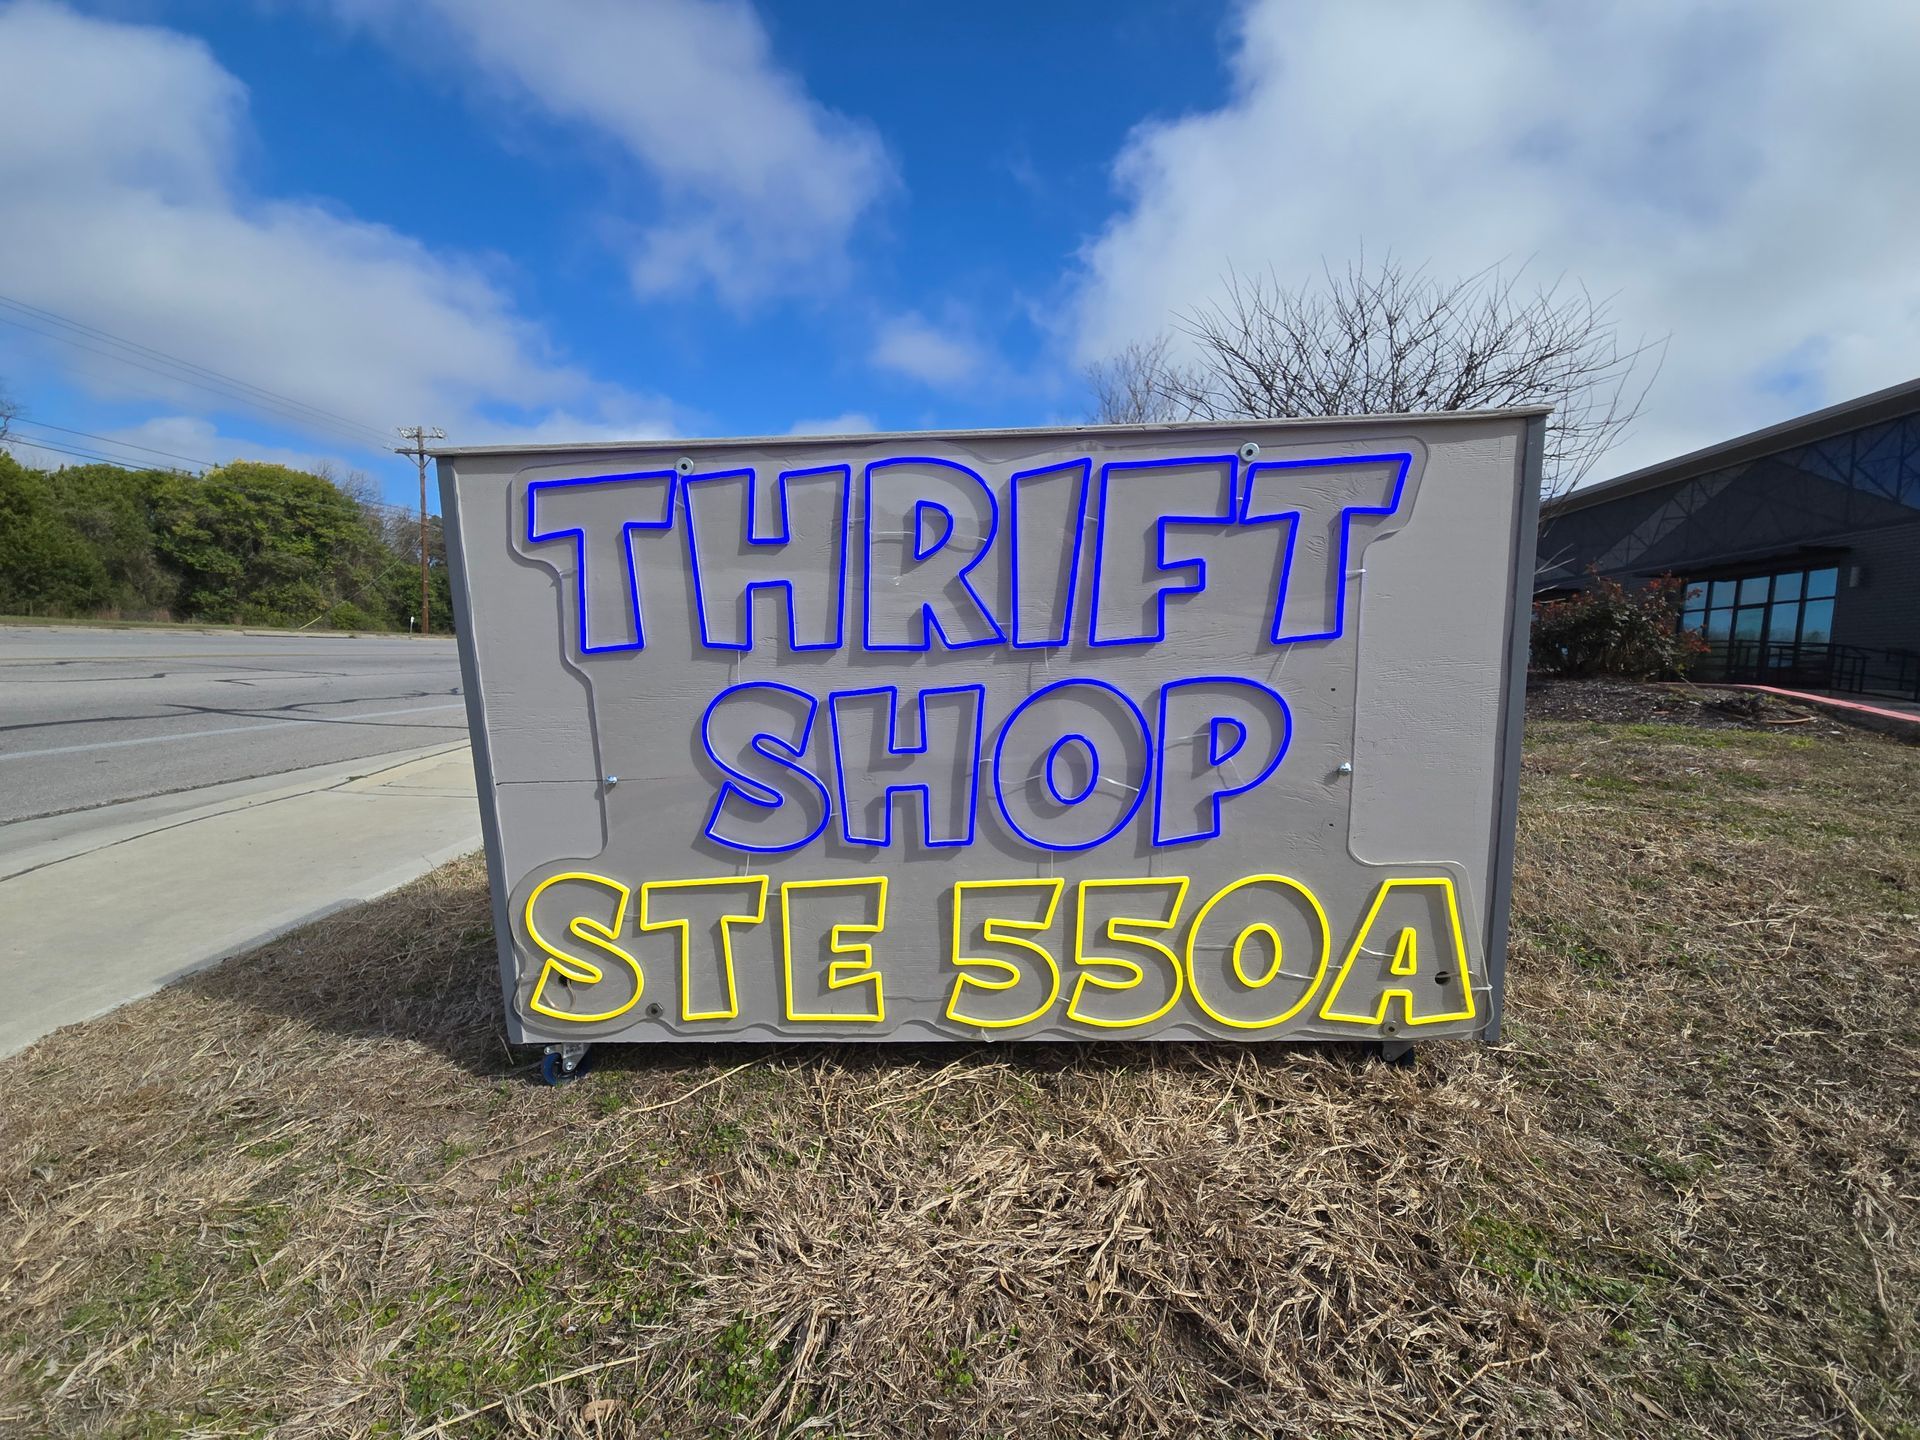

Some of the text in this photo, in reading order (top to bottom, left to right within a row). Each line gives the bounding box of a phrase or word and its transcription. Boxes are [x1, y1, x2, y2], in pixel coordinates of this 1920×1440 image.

[528, 455, 1411, 654] THRIFT
[702, 678, 1292, 851] SHOP
[525, 873, 1477, 1029] STE 550A
